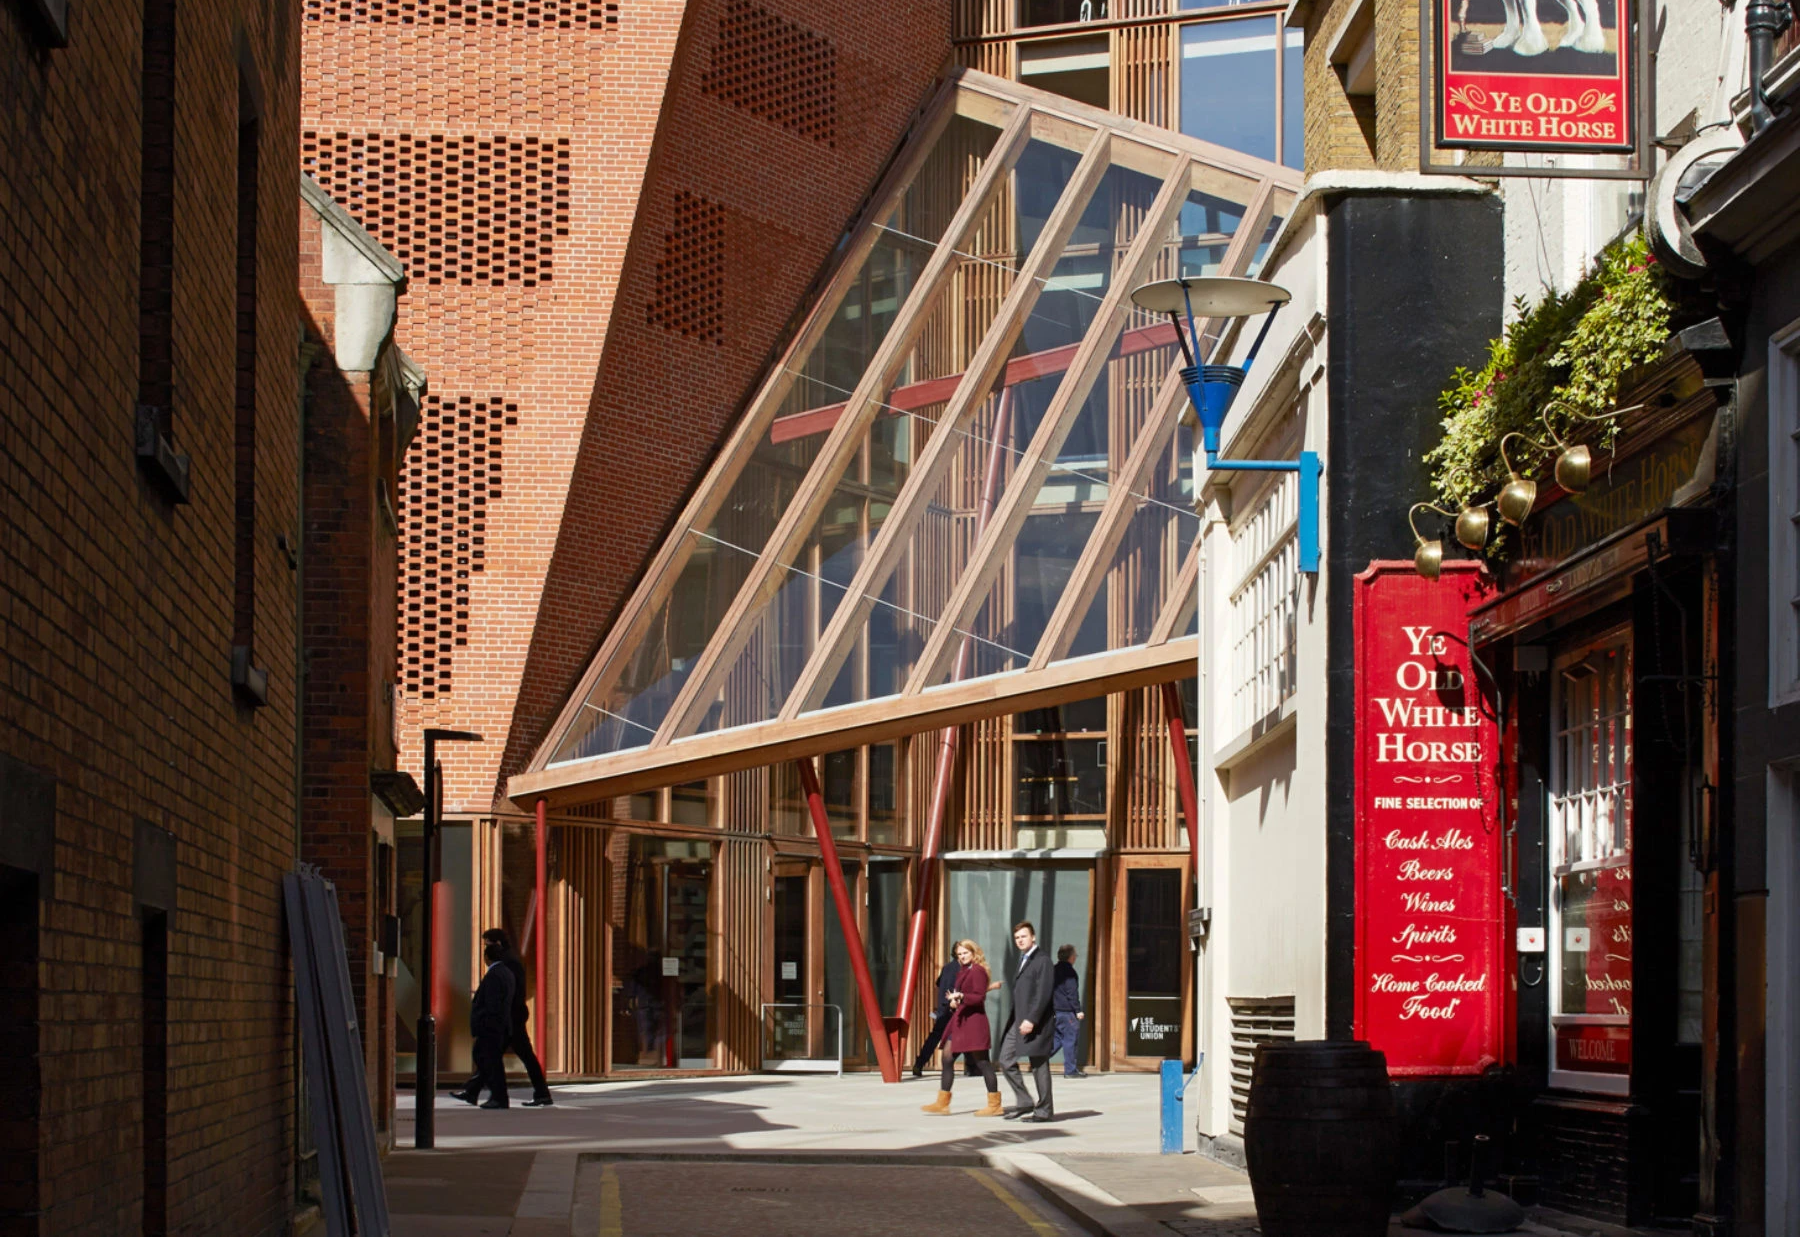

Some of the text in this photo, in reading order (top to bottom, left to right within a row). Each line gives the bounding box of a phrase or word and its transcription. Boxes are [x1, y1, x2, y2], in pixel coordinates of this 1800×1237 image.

[1451, 114, 1616, 139] WHITE HORSE
[1374, 697, 1482, 728] WHITE
[1376, 732, 1482, 763] HORSE
[1374, 797, 1484, 810] FINE SELECTION OF
[1382, 828, 1474, 851] Cask Ales
[1396, 858, 1455, 882] Beers
[1400, 891, 1456, 913] Wines
[1391, 923, 1457, 951] Spirits
[1371, 972, 1487, 994] Home Cooked
[1568, 1038, 1617, 1062] WELCOME
